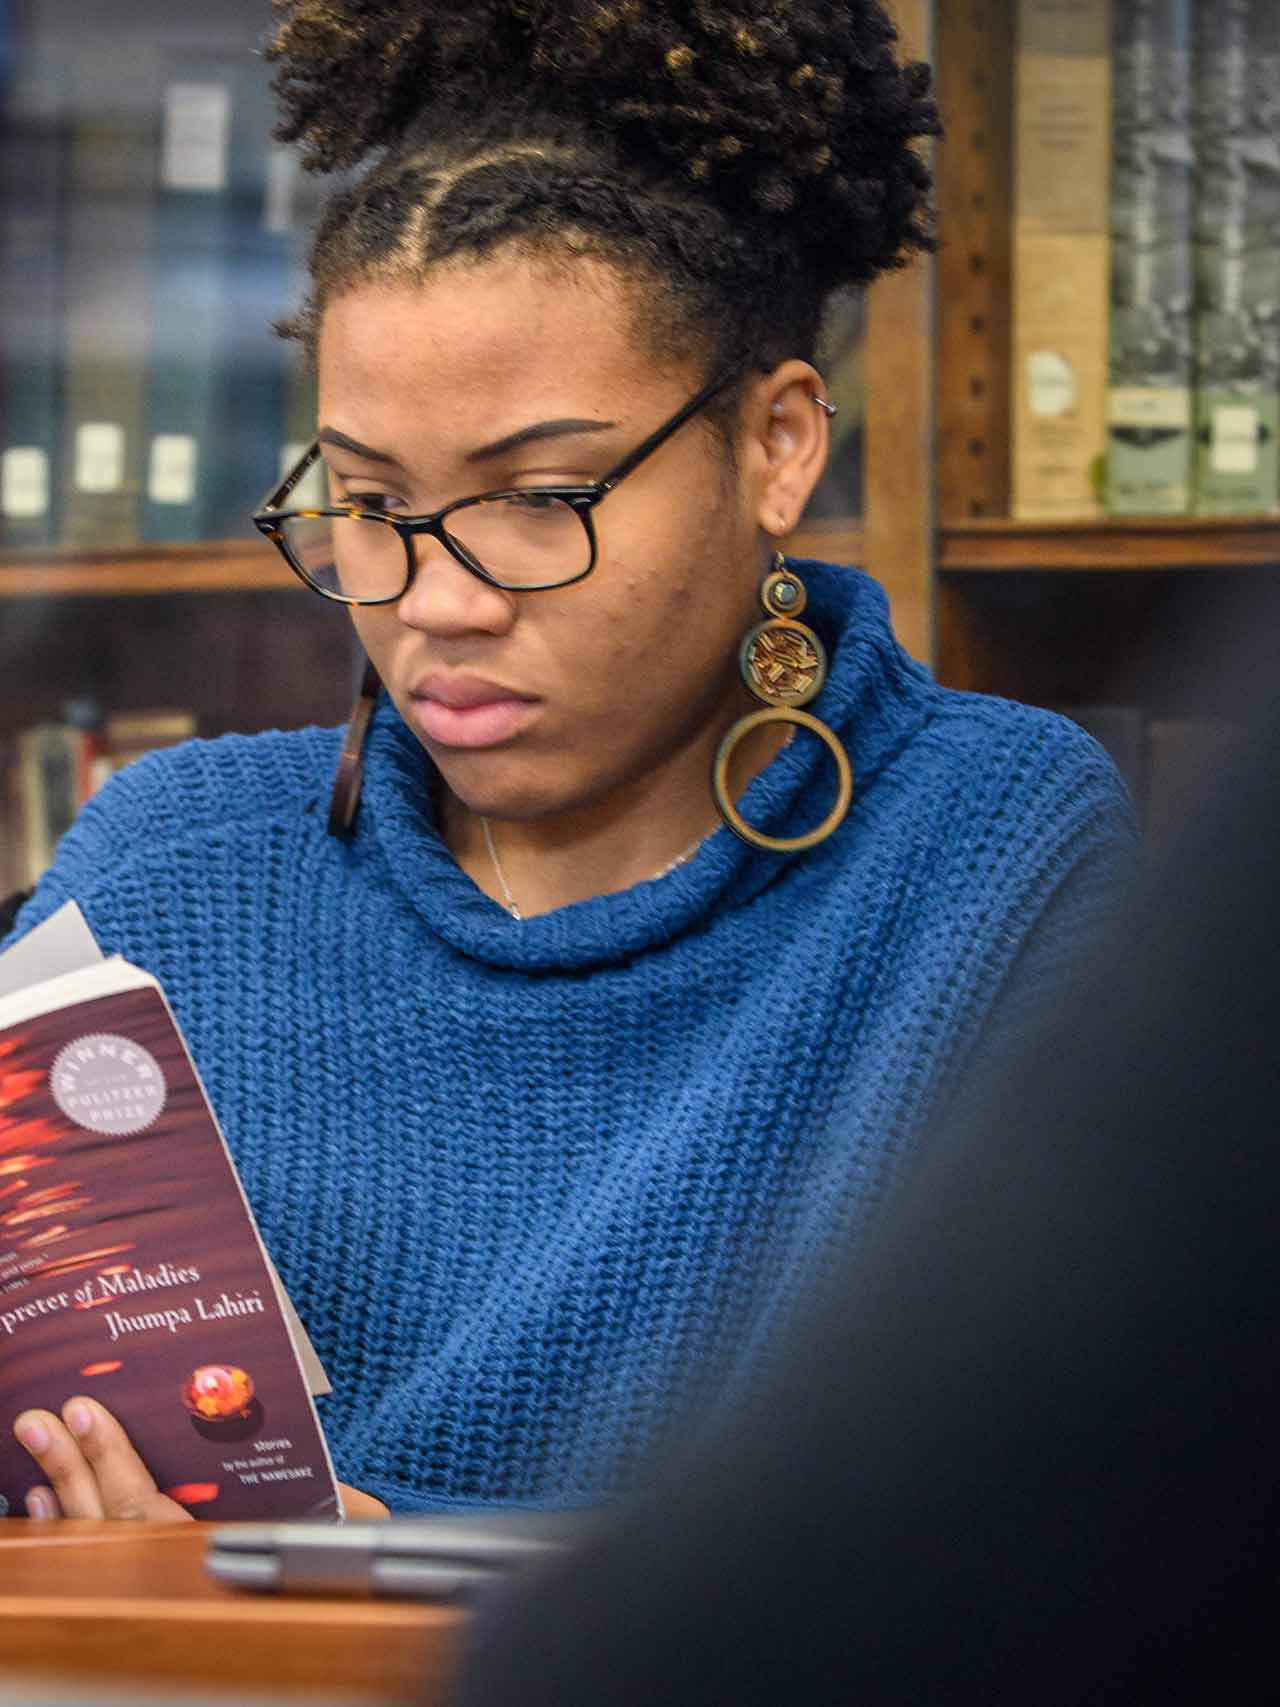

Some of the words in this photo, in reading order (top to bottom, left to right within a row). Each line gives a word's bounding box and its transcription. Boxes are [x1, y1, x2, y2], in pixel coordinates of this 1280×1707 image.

[59, 1042, 154, 1091] WINNER
[73, 1279, 94, 1310] of
[97, 1263, 201, 1297] Maladies
[104, 1306, 193, 1341] Jhumpa
[193, 1290, 265, 1322] Lahiri
